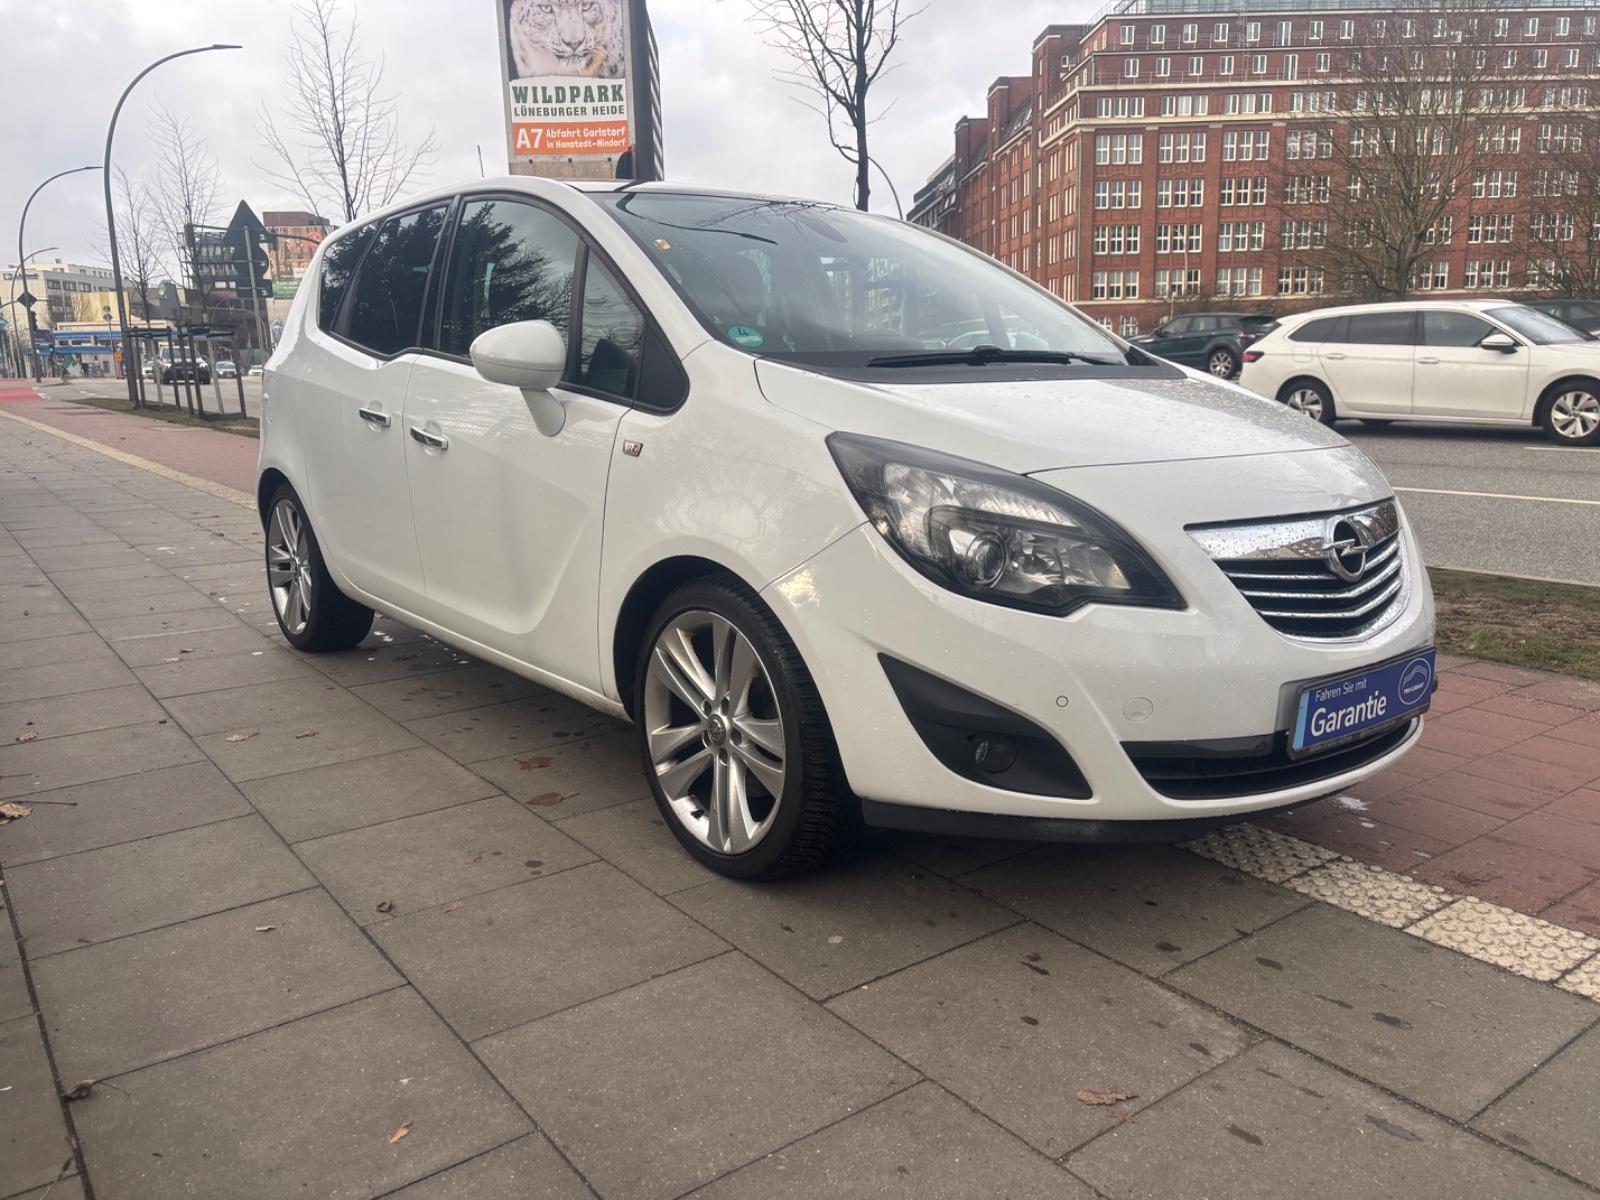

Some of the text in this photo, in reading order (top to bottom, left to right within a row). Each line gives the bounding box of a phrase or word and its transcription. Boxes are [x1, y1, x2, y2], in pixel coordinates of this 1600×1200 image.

[512, 84, 624, 104] WILDPARK
[514, 104, 625, 117] LÜNEBURGER HEIDE
[516, 128, 543, 149] A7
[546, 128, 582, 139] Abfahrt
[1314, 676, 1367, 703] Fahren Sie mit
[1311, 690, 1387, 737] Garantie
